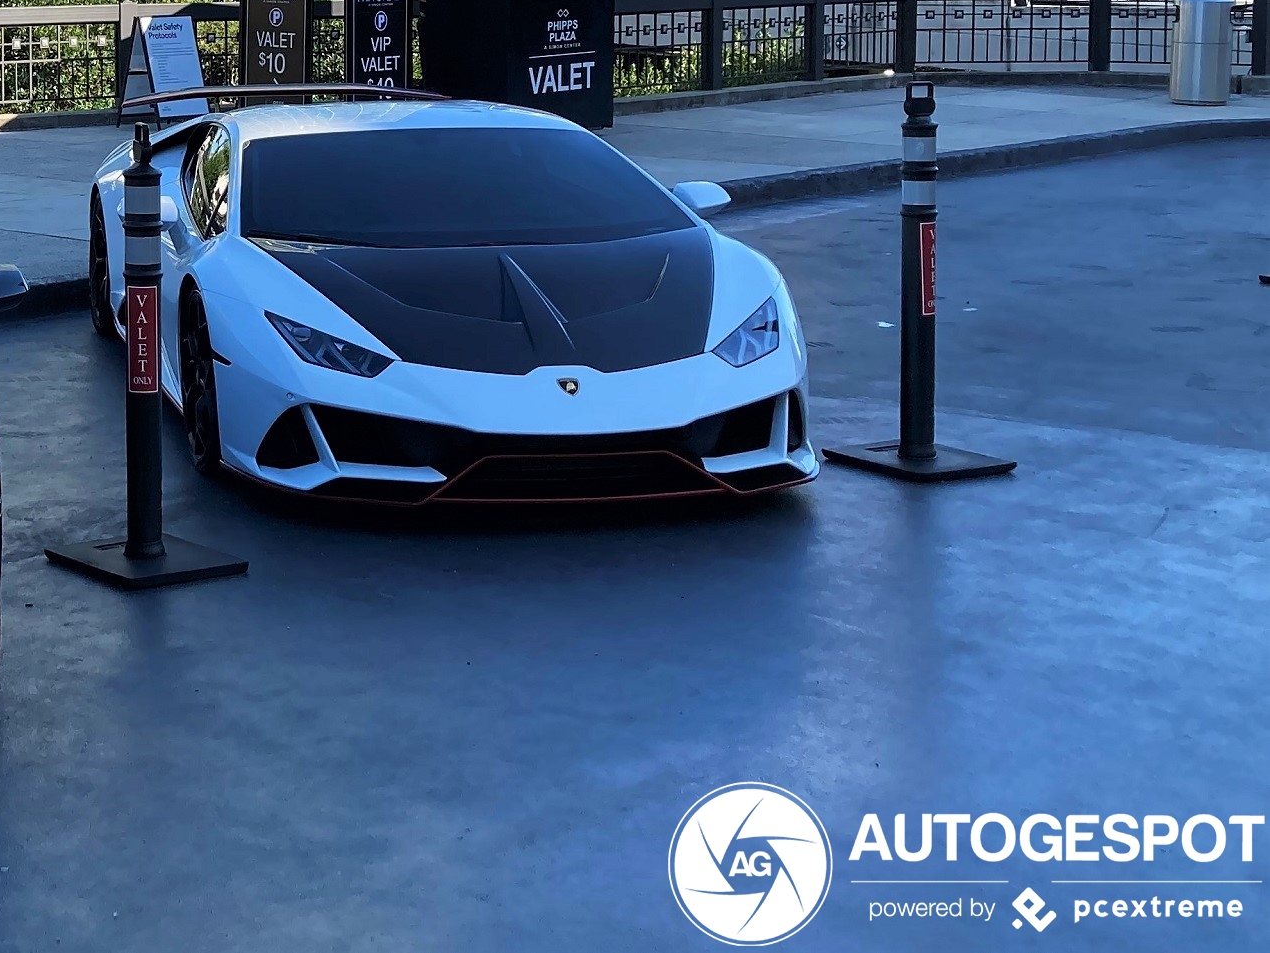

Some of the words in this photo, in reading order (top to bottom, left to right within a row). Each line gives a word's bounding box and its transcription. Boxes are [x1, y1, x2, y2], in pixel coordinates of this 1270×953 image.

[164, 22, 183, 32] Safety
[547, 19, 579, 32] PHIPPS
[256, 30, 296, 49] VALET
[370, 36, 392, 52] VIP
[549, 31, 577, 42] PLAZA
[258, 51, 286, 74] $10
[360, 55, 400, 73] VALET
[528, 61, 596, 95] VALET
[136, 294, 148, 373] VALET
[133, 375, 153, 385] ONLY
